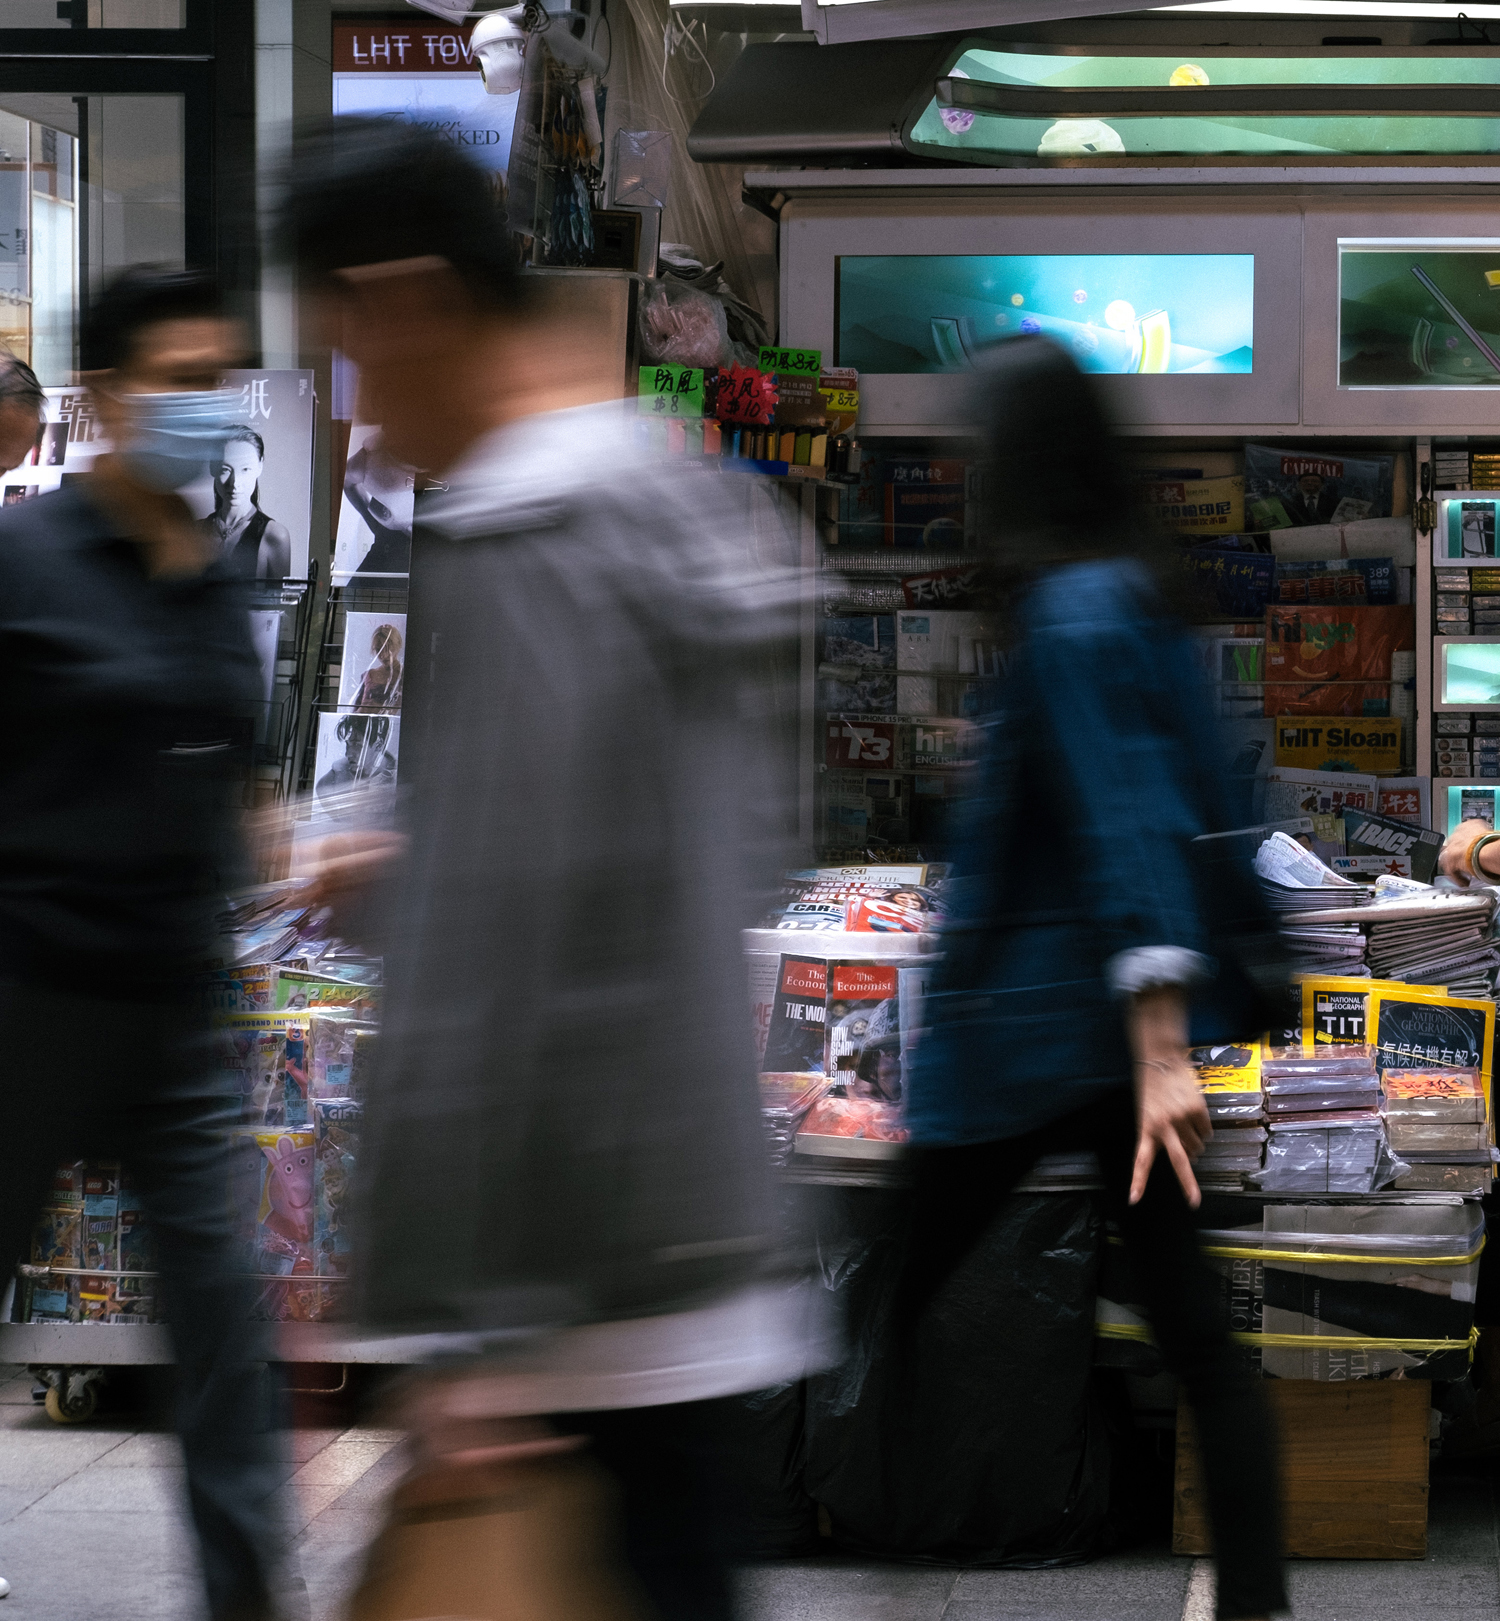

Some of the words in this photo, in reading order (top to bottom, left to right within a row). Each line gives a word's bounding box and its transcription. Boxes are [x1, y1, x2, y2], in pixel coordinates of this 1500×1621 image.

[352, 35, 411, 64] LHT
[655, 368, 698, 393] 防風
[1283, 461, 1342, 478] CAPITAL
[1369, 567, 1390, 578] 389
[1271, 612, 1355, 650] hinge
[1280, 728, 1322, 747] MIT
[1326, 728, 1397, 747] Sloan
[1350, 821, 1418, 857] iRACE
[793, 904, 831, 912] CAR
[808, 970, 825, 980] The
[856, 972, 874, 982] The
[310, 988, 320, 999] 2
[837, 982, 892, 992] Economist
[1330, 996, 1360, 1004] NATIONAL
[785, 1001, 803, 1020] THE
[1411, 1011, 1452, 1025] NATIONAL
[1321, 1015, 1365, 1035] TIT
[1401, 1019, 1462, 1036] GEOGRAPHIC
[831, 1026, 849, 1041] HOW
[830, 1041, 855, 1056] SCARY
[830, 1056, 838, 1071] IS
[830, 1070, 856, 1086] CHINA?
